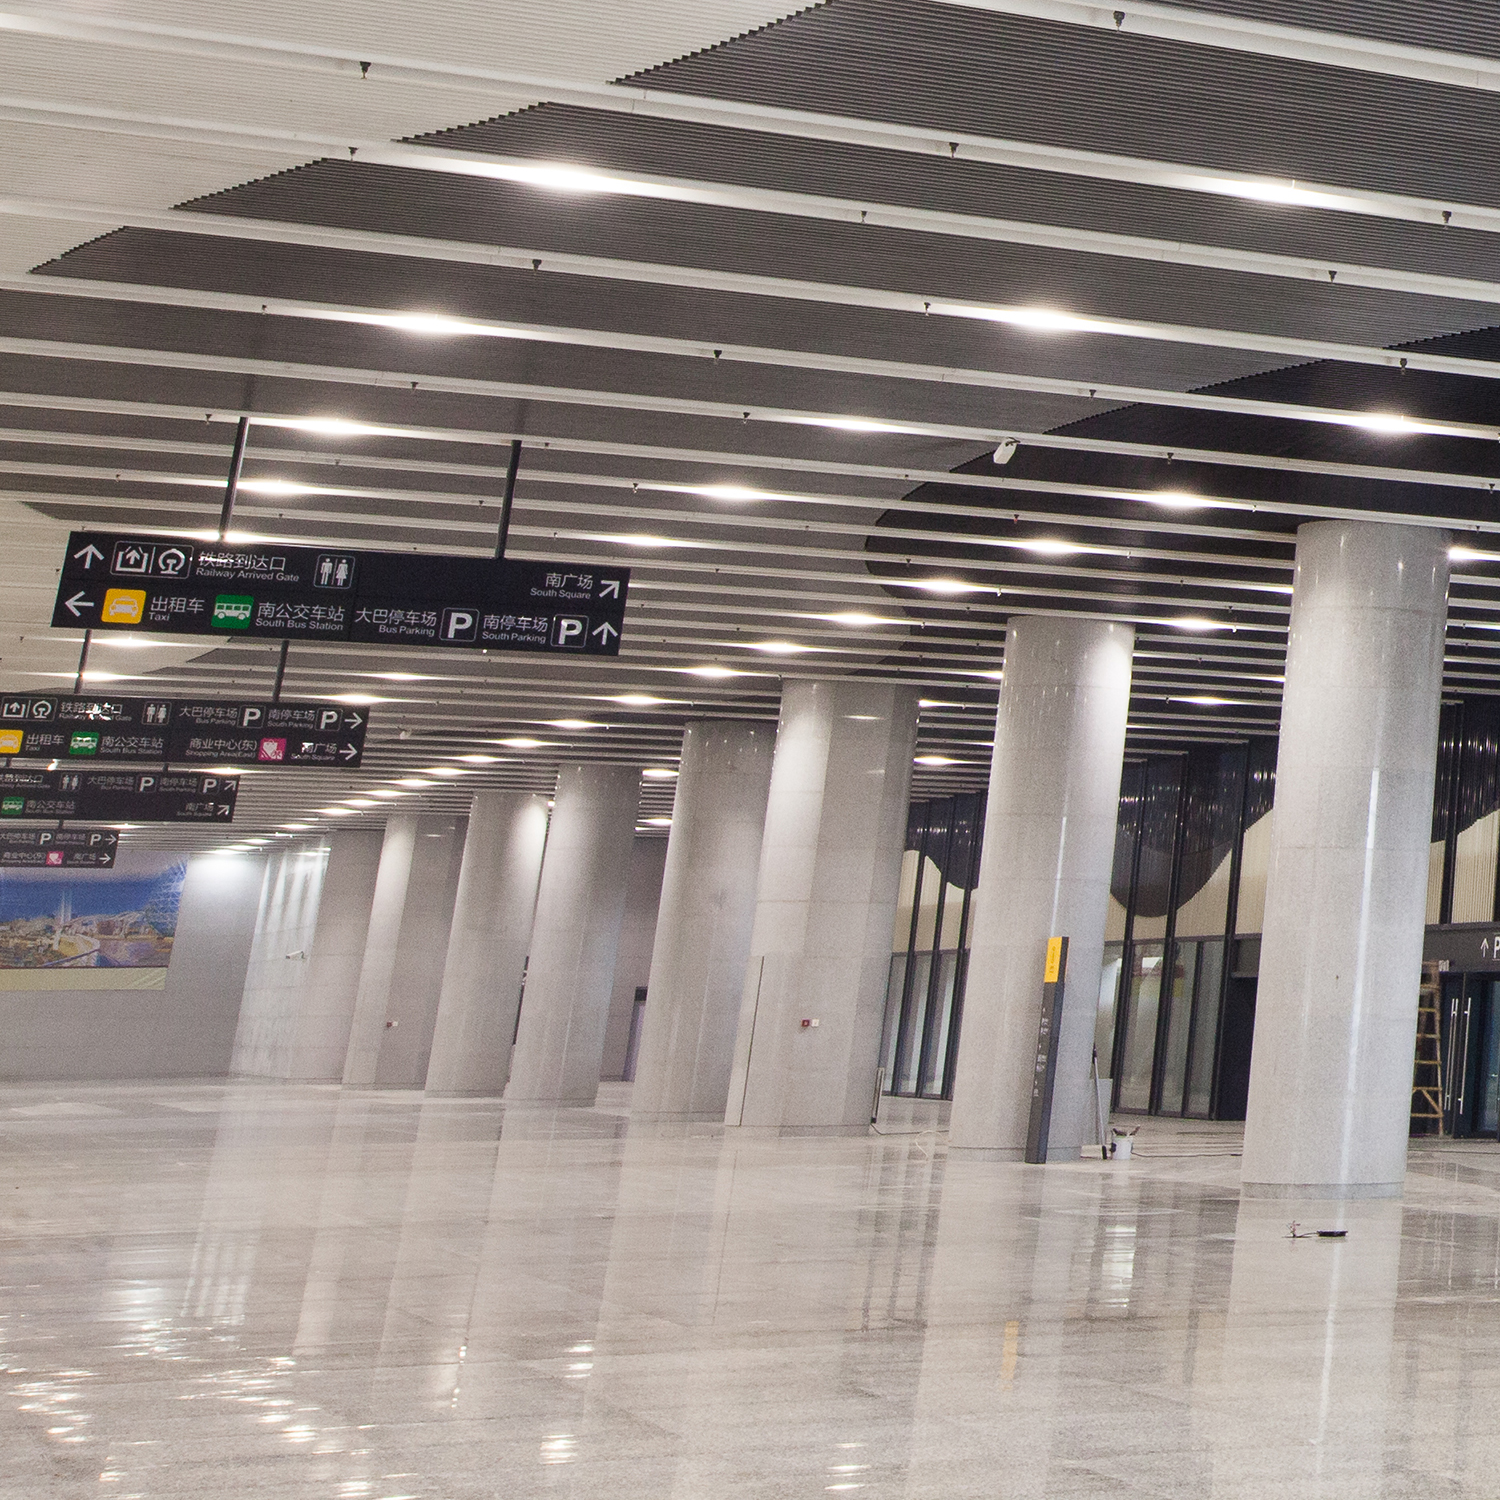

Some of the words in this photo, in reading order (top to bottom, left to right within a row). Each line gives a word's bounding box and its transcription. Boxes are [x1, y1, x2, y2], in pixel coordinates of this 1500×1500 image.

[198, 550, 286, 572] 铁路到达口
[196, 567, 235, 579] Railway
[237, 569, 274, 581] Arrived
[275, 571, 300, 583] Gate
[545, 572, 594, 590] 南广场
[529, 587, 557, 598] South
[558, 589, 592, 601] Square
[150, 595, 205, 614] 出租车
[257, 601, 346, 623] 南公交车站
[149, 611, 171, 621] Taxi
[255, 617, 285, 628] South
[287, 619, 307, 629] Bus
[309, 620, 344, 631] Station
[354, 607, 438, 627] 大巴停车场
[482, 614, 549, 633] 南停车场
[378, 624, 398, 634] Bus
[399, 626, 435, 637] Parking
[447, 611, 474, 639] P
[557, 618, 583, 645] P
[481, 630, 510, 641] South
[511, 632, 547, 644] Parking
[178, 705, 238, 719] 大巴停车场
[243, 707, 261, 727] P
[319, 710, 339, 730] P
[26, 732, 65, 746] 出租车
[101, 735, 164, 749] 南公交车站
[139, 776, 155, 792] P
[202, 778, 218, 794] P
[39, 832, 52, 845] P
[89, 833, 102, 846] P
